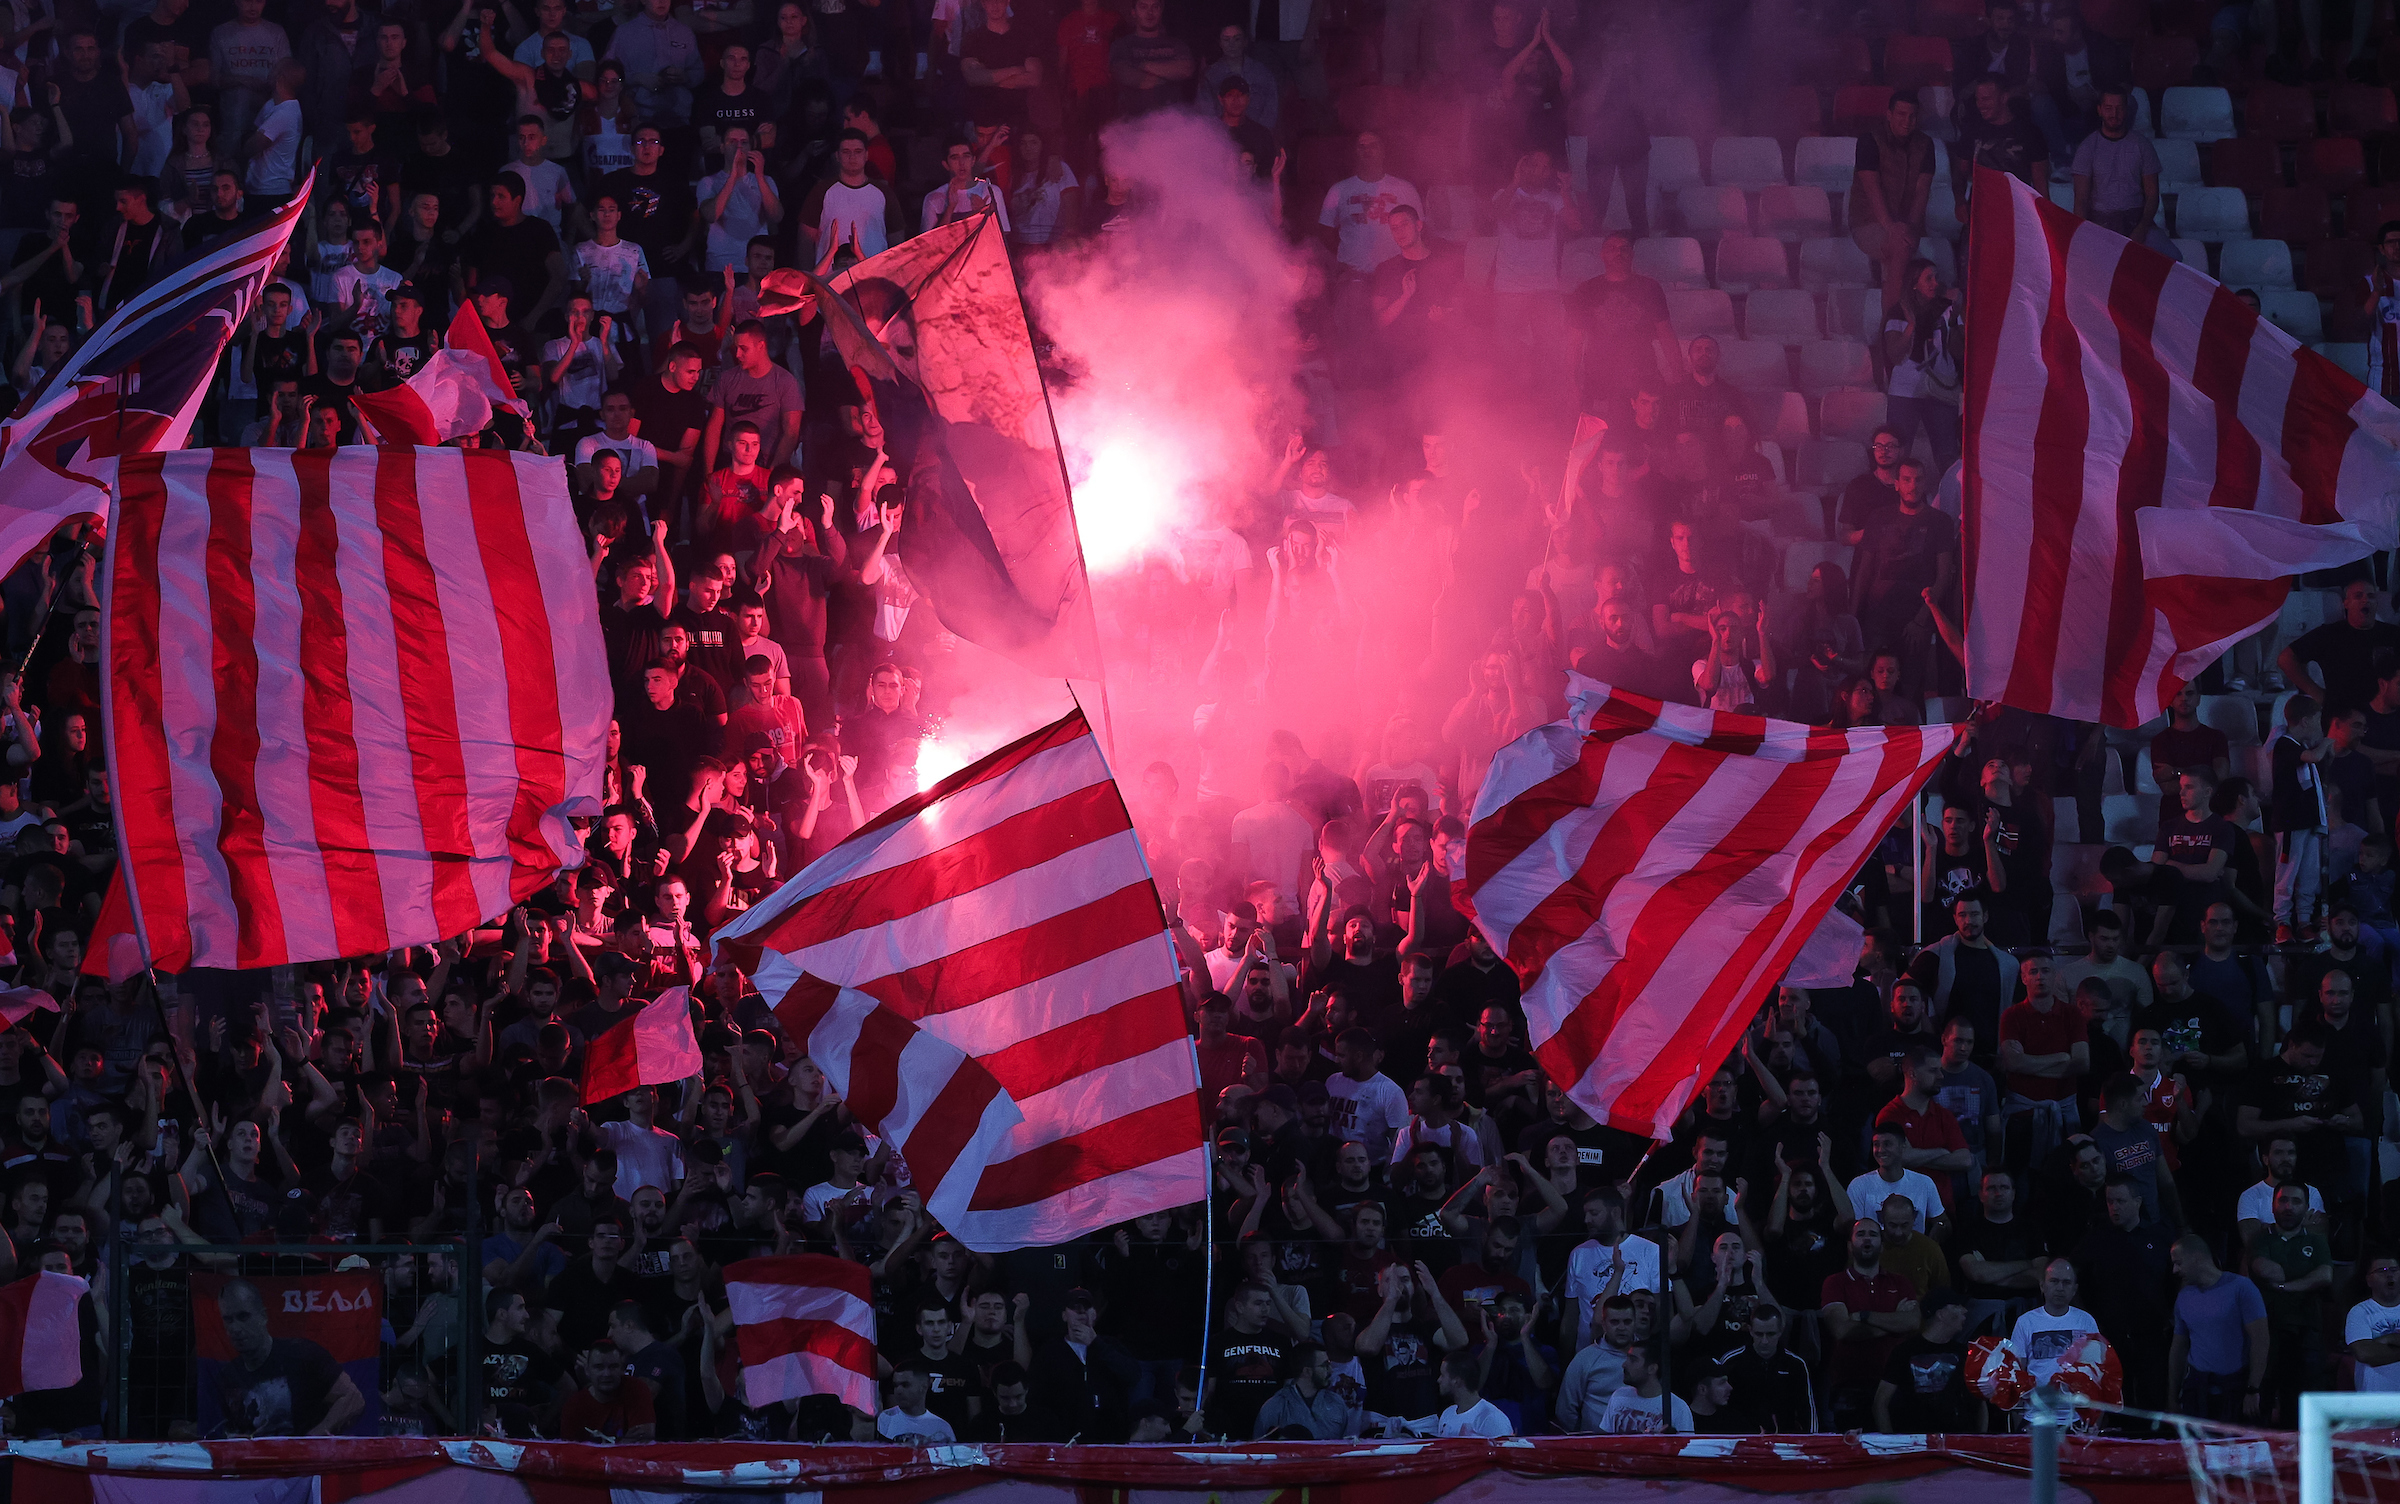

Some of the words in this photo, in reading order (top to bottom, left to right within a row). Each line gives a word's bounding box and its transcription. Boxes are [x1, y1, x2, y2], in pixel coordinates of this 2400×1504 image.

[228, 45, 274, 56] CRAZY
[230, 58, 274, 69] NORTH
[716, 108, 756, 119] GUESS
[734, 393, 768, 408] NIKE
[2114, 1141, 2150, 1160] CRAZY
[2116, 1151, 2156, 1172] NORTH
